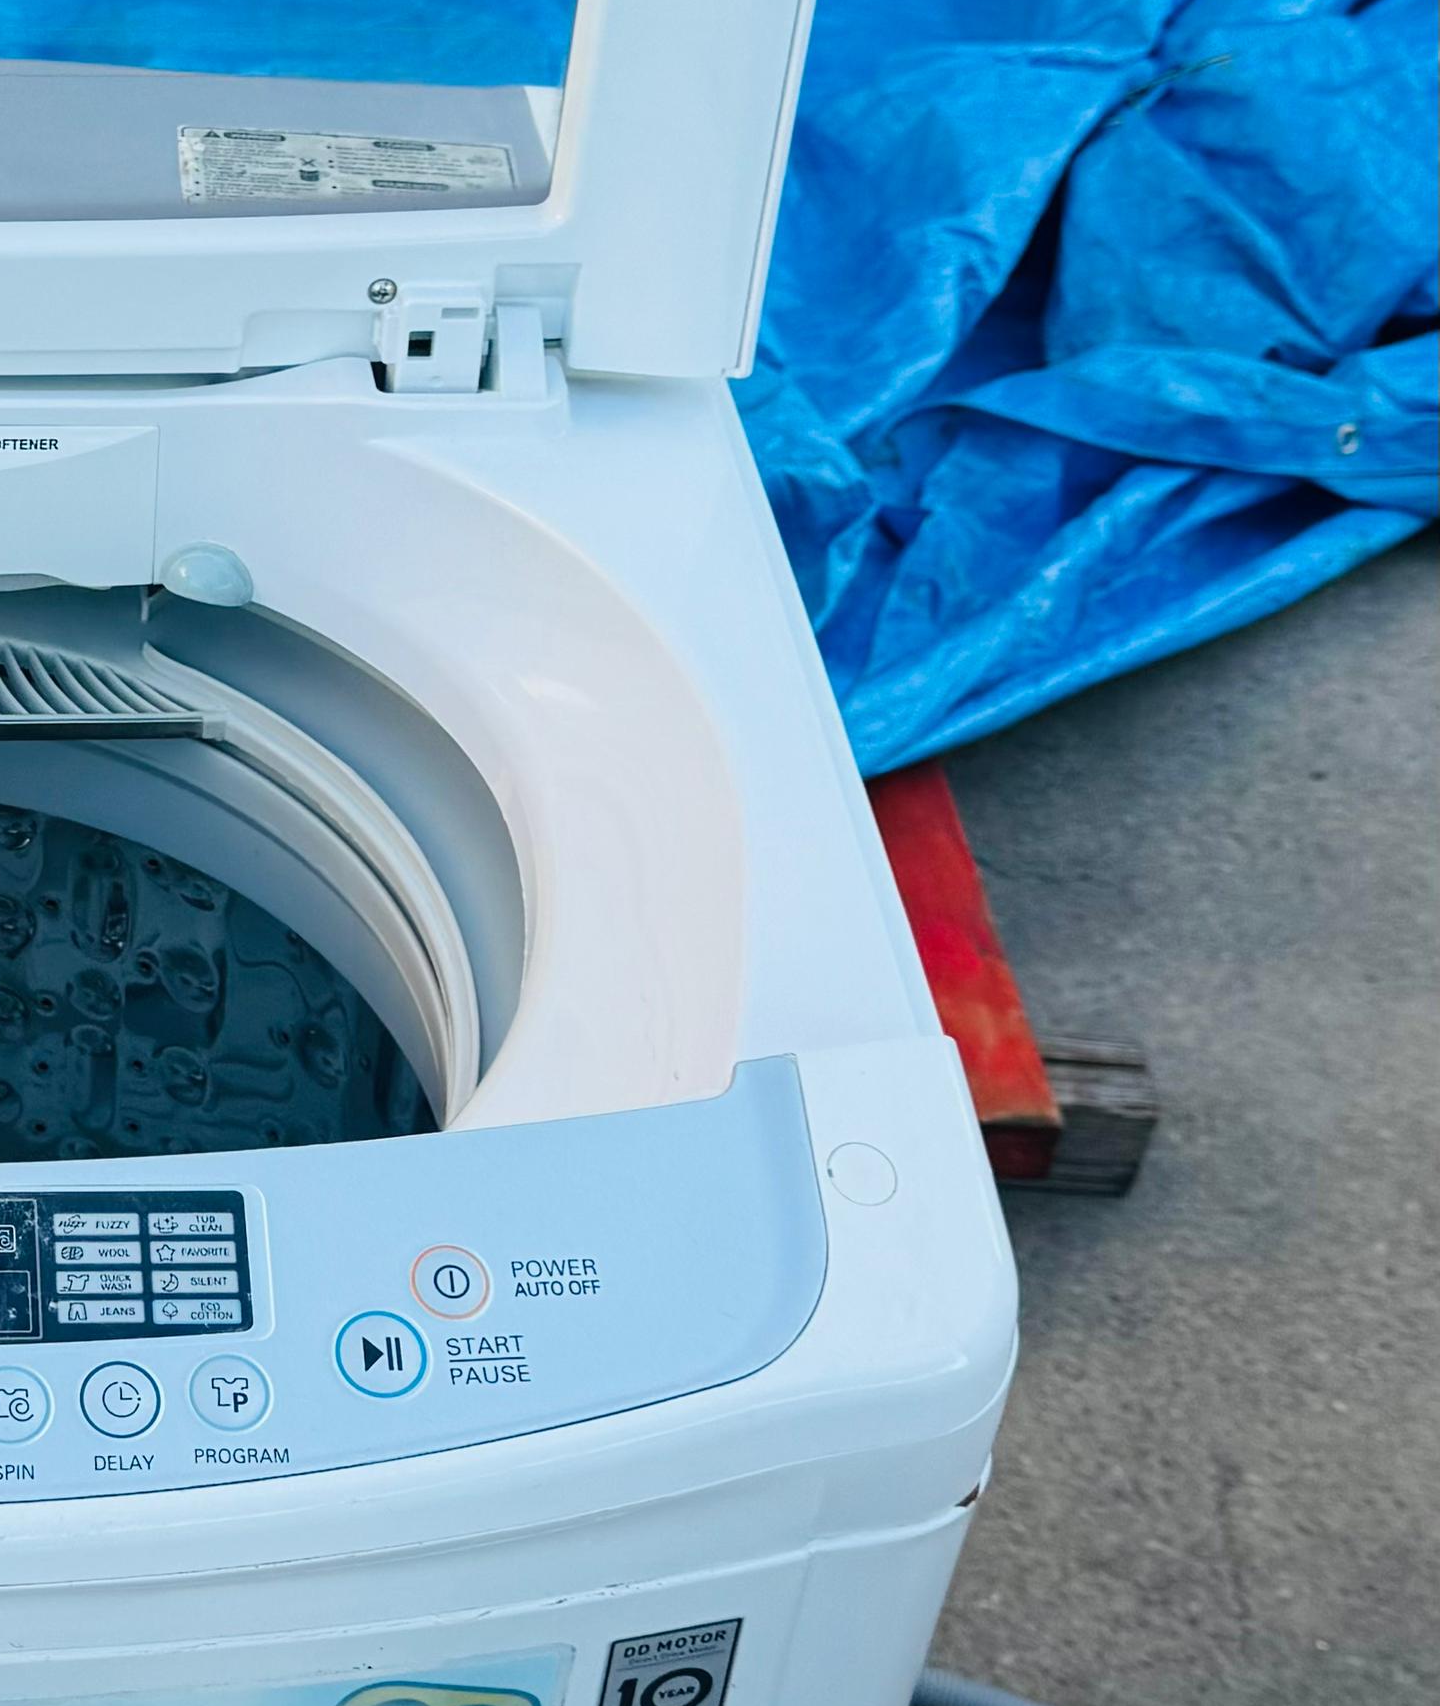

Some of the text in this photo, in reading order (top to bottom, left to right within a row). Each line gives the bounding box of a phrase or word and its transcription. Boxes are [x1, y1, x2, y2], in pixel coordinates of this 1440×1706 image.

[96, 1220, 130, 1229] FUZZY
[181, 1248, 229, 1256] FAVORITE
[511, 1259, 597, 1278] POWER
[191, 1278, 227, 1286] SILENT
[515, 1280, 600, 1297] AUTO OFF
[100, 1308, 135, 1316] JEANS
[191, 1312, 233, 1320] COTTON
[446, 1336, 523, 1356] START
[450, 1365, 531, 1385] PAUSE
[94, 1455, 154, 1472] DELAY
[194, 1449, 289, 1464] PROGRAM
[624, 1630, 727, 1658] DD MOTOR
[659, 1686, 695, 1698] YEAR
